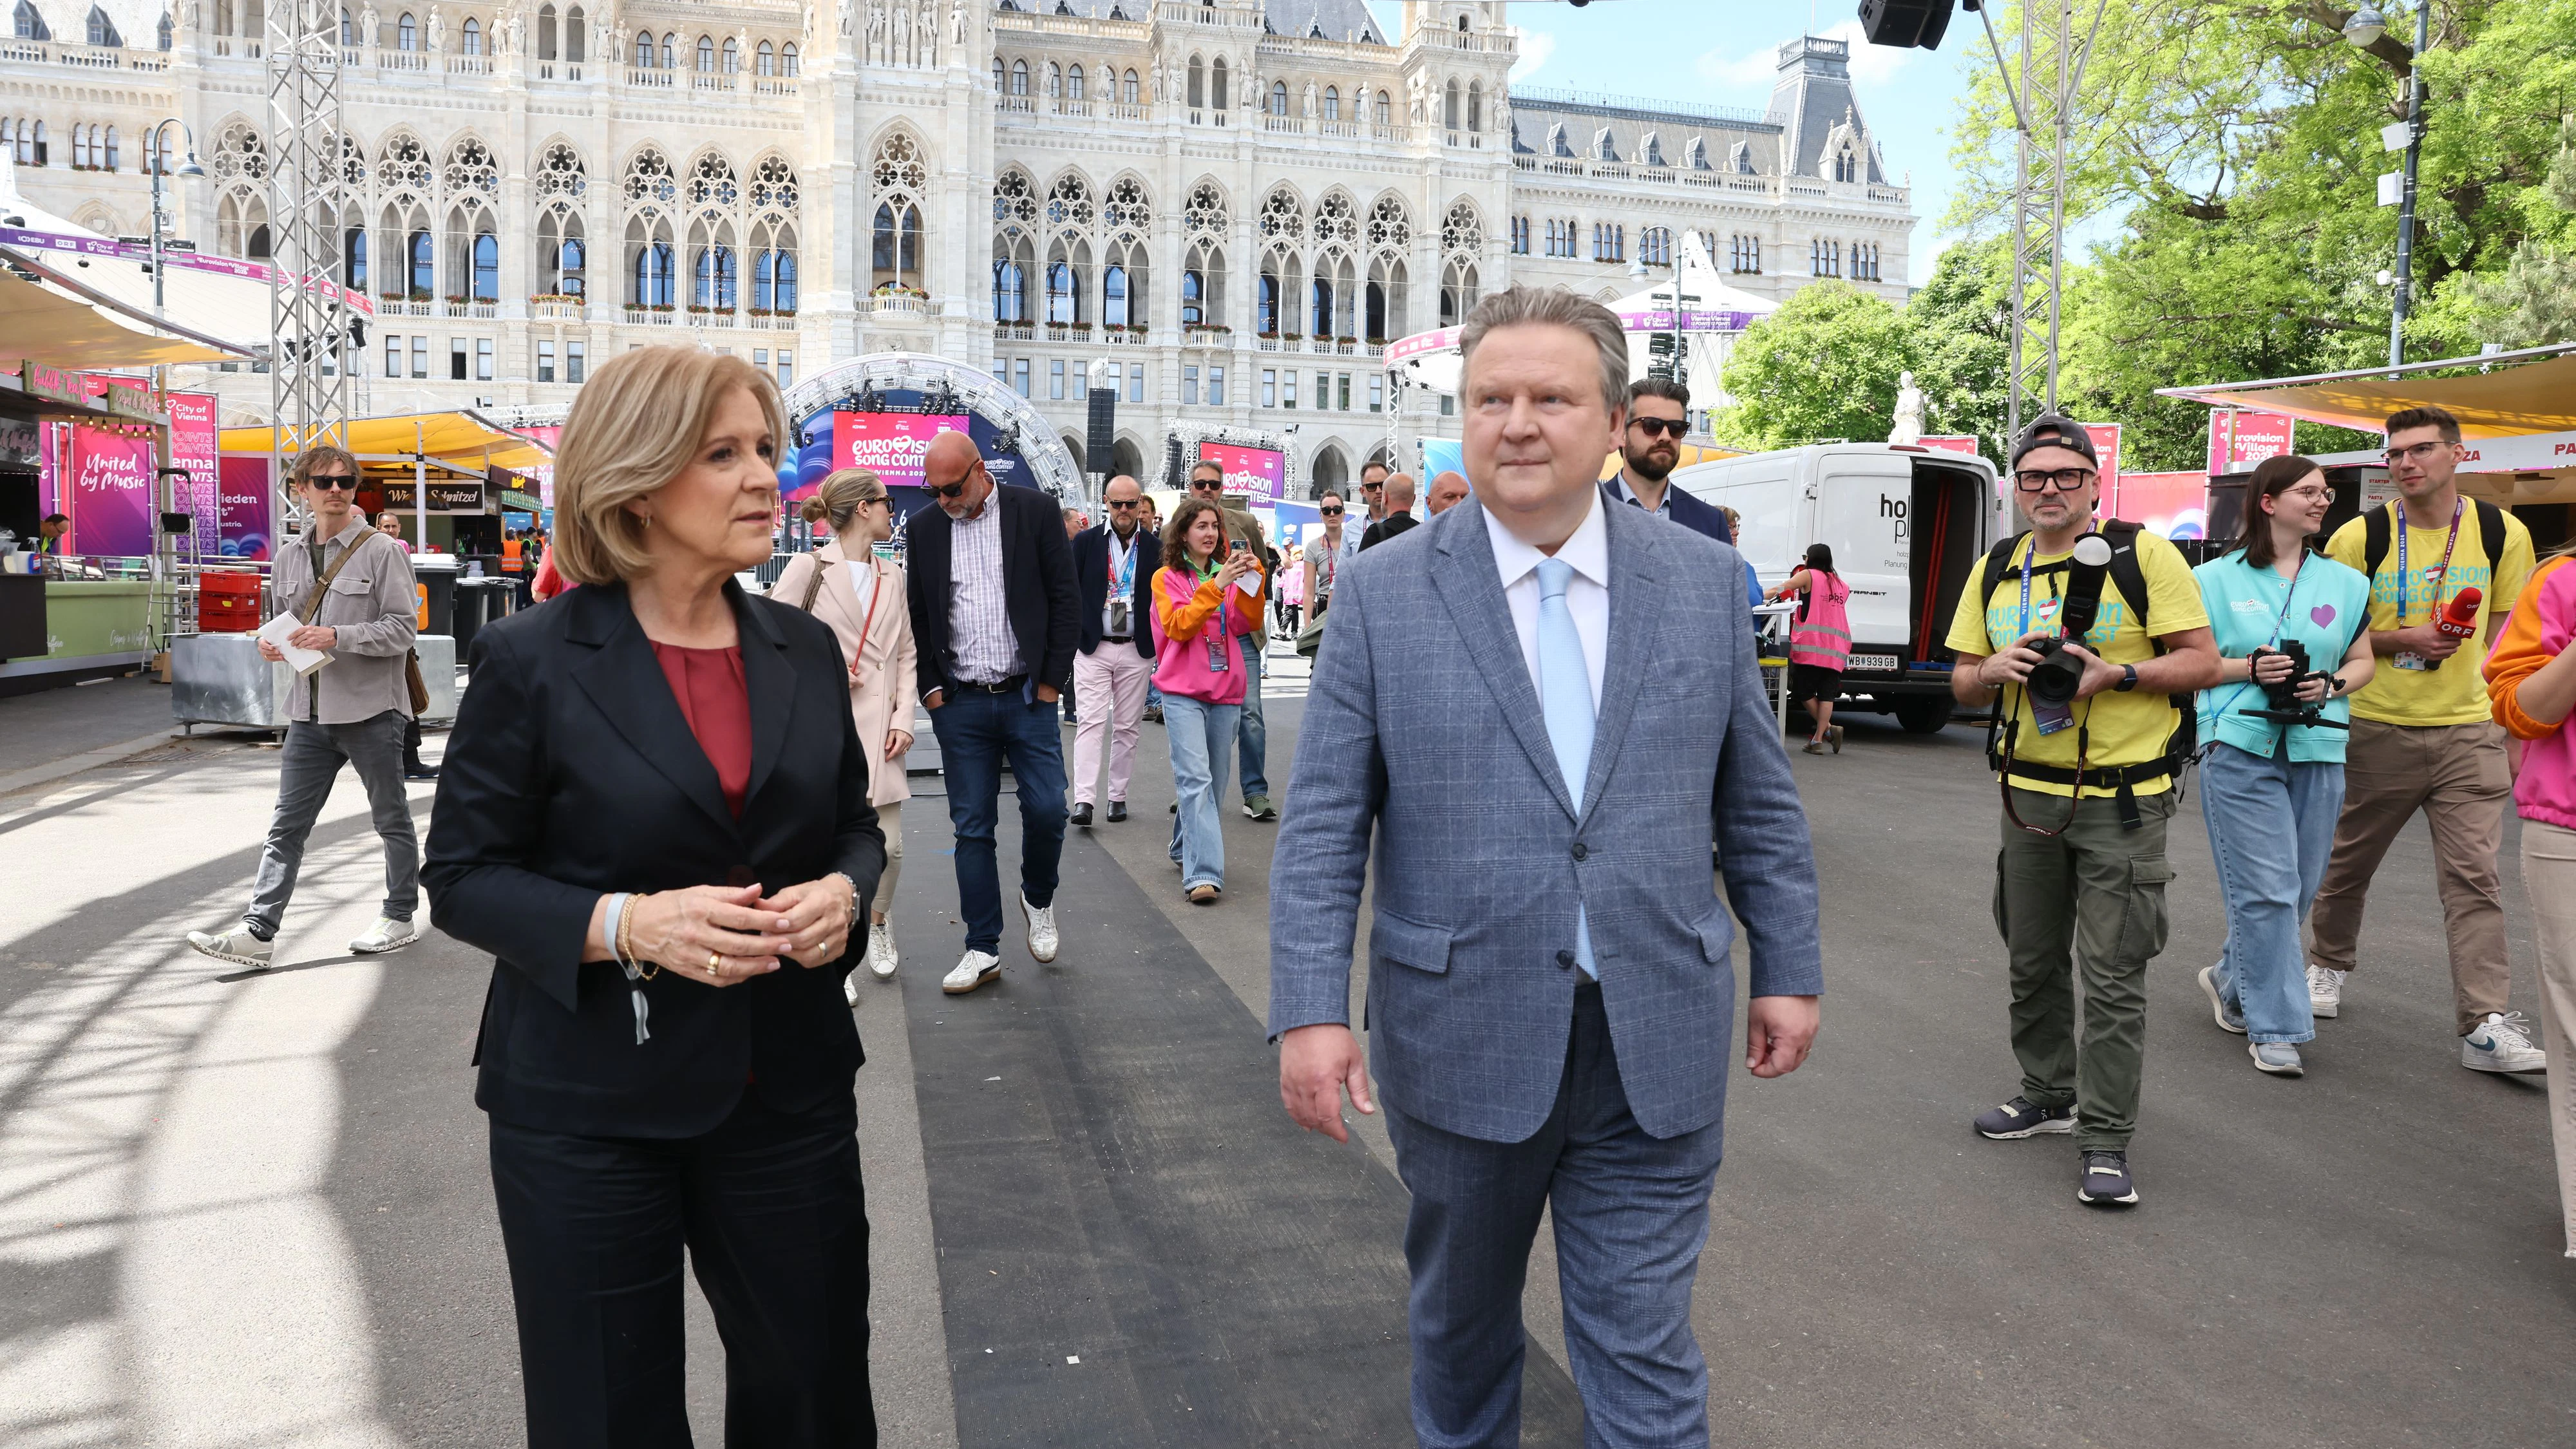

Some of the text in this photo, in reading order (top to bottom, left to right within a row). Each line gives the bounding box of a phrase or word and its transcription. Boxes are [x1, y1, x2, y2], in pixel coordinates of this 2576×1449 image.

[197, 257, 228, 267] Eurovision
[176, 404, 194, 414] City
[176, 412, 207, 421] Vienna
[2235, 442, 2279, 453] Village
[86, 453, 138, 473] United
[80, 469, 145, 492] by Music
[2447, 532, 2456, 554] VIENNA
[1884, 560, 1908, 570] Planung
[2441, 623, 2473, 636] ORF
[1848, 656, 1895, 667] WB 939 GB
